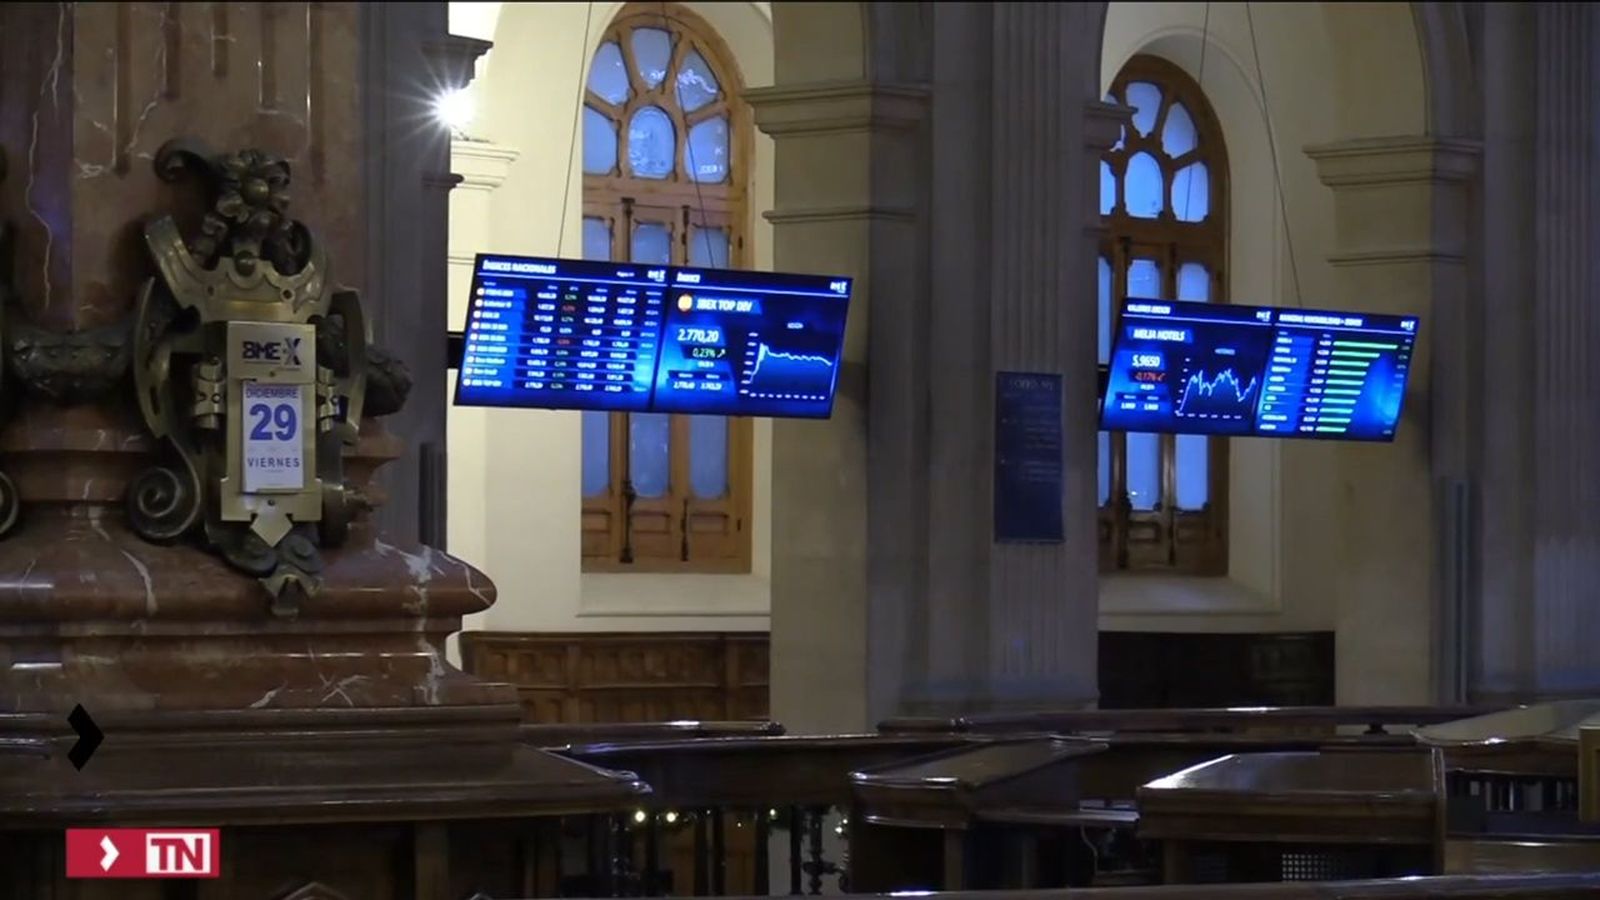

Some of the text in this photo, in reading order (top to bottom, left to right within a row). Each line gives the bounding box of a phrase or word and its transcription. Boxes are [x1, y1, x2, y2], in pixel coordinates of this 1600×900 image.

[696, 298, 753, 313] IBEX TOP DIV
[677, 328, 719, 343] 2.770,20
[1157, 330, 1186, 341] HOTELS
[692, 348, 716, 358] 0,23%
[246, 387, 299, 399] DICIEMBRE
[249, 403, 298, 442] 29
[247, 457, 300, 468] VIERNES
